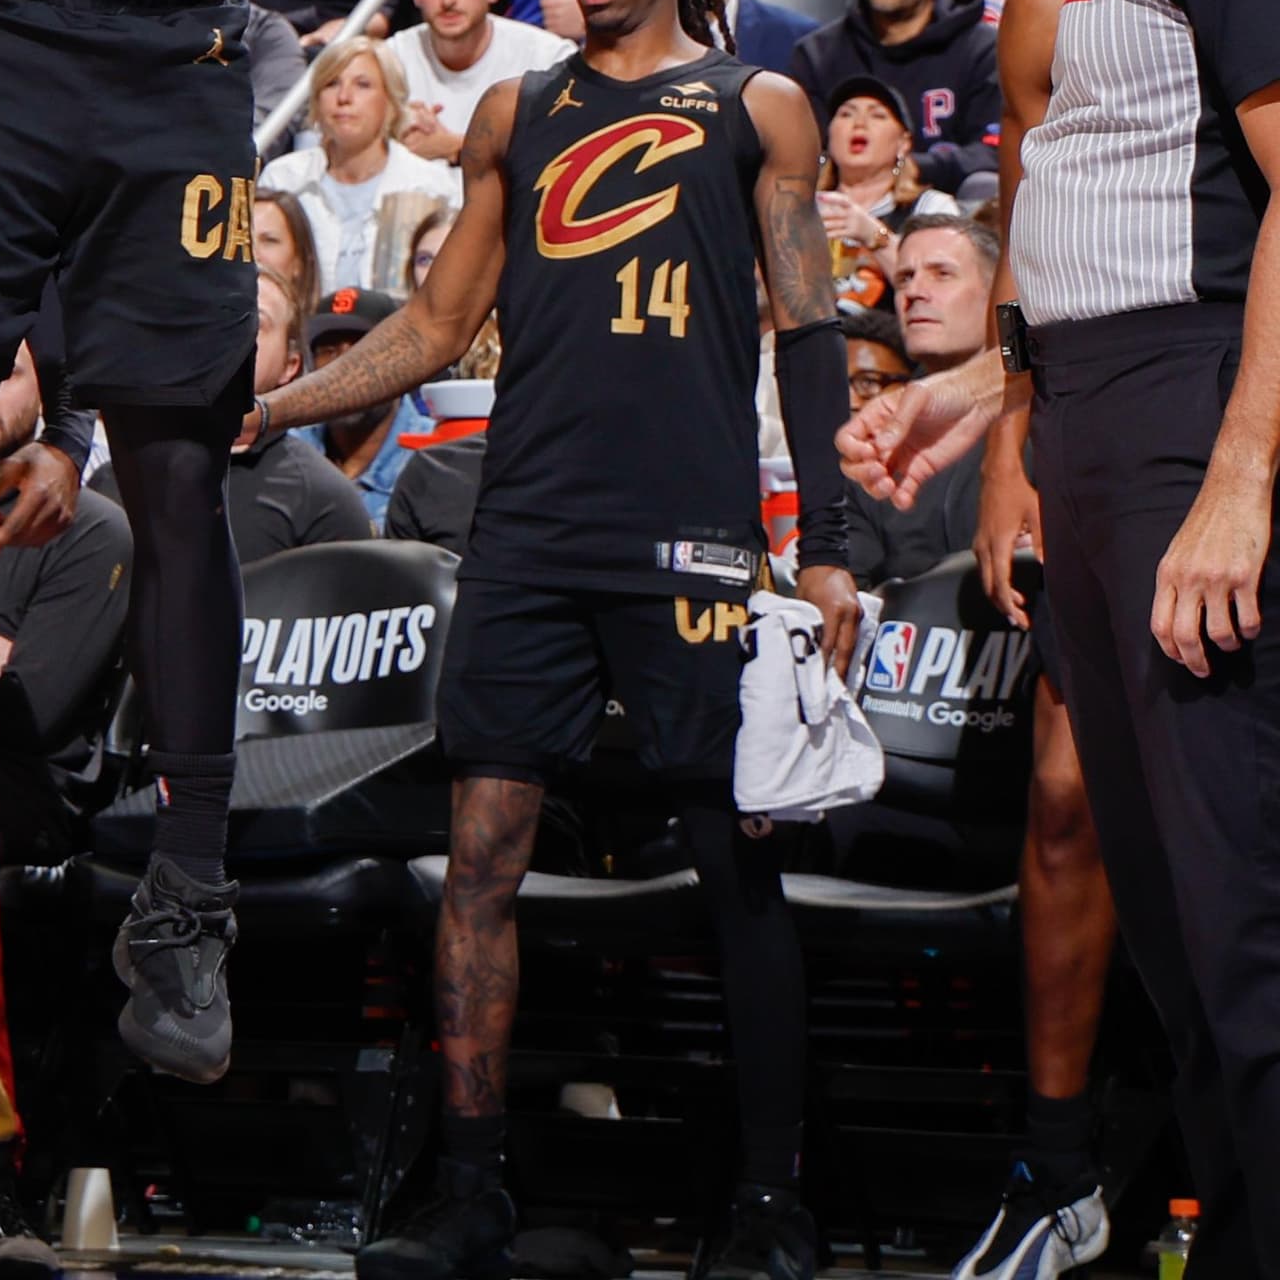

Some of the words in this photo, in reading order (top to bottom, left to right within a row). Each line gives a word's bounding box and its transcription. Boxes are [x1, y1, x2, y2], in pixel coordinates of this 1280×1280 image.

[659, 95, 719, 113] CLIFFS
[922, 87, 955, 138] P
[180, 173, 256, 263] CA
[591, 256, 691, 339] 14
[241, 603, 437, 687] PLAYOFFS
[244, 688, 329, 716] Google
[862, 694, 908, 718] Presented
[927, 701, 1015, 732] Google
